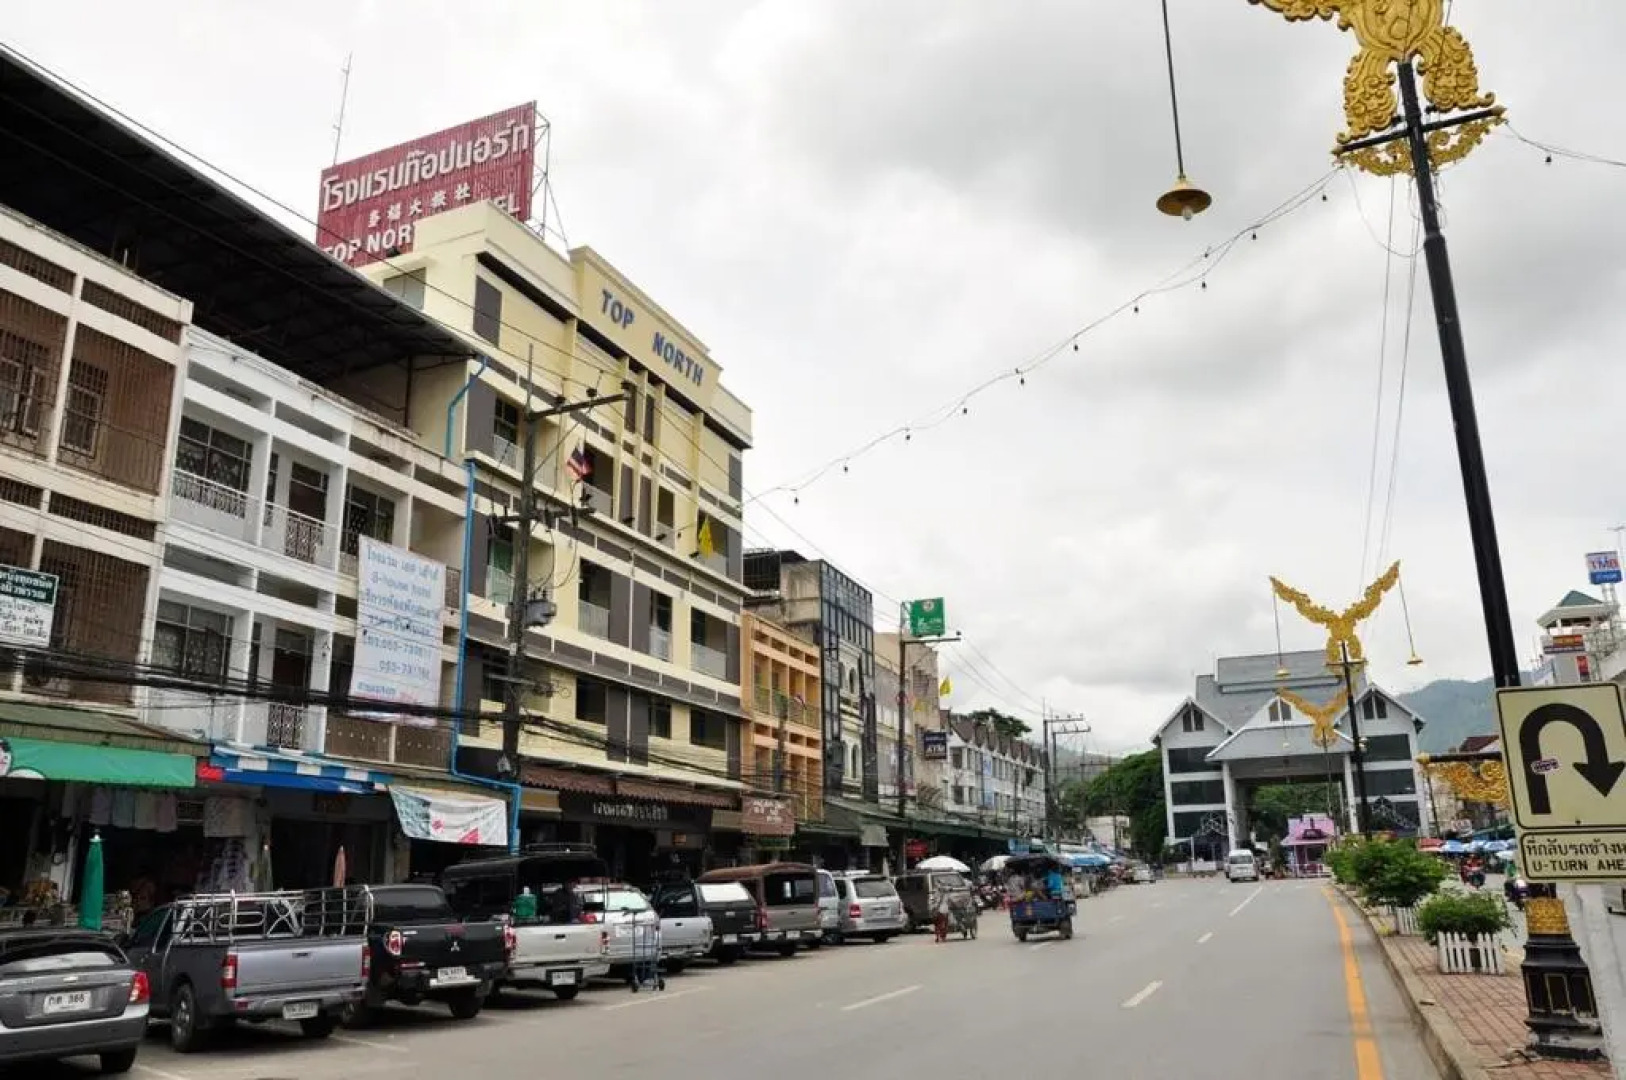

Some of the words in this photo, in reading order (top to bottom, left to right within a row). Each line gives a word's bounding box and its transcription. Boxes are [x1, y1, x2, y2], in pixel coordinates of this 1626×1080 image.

[602, 289, 635, 330] TOP
[653, 332, 704, 387] NORTH
[1532, 860, 1588, 872] U-TURN
